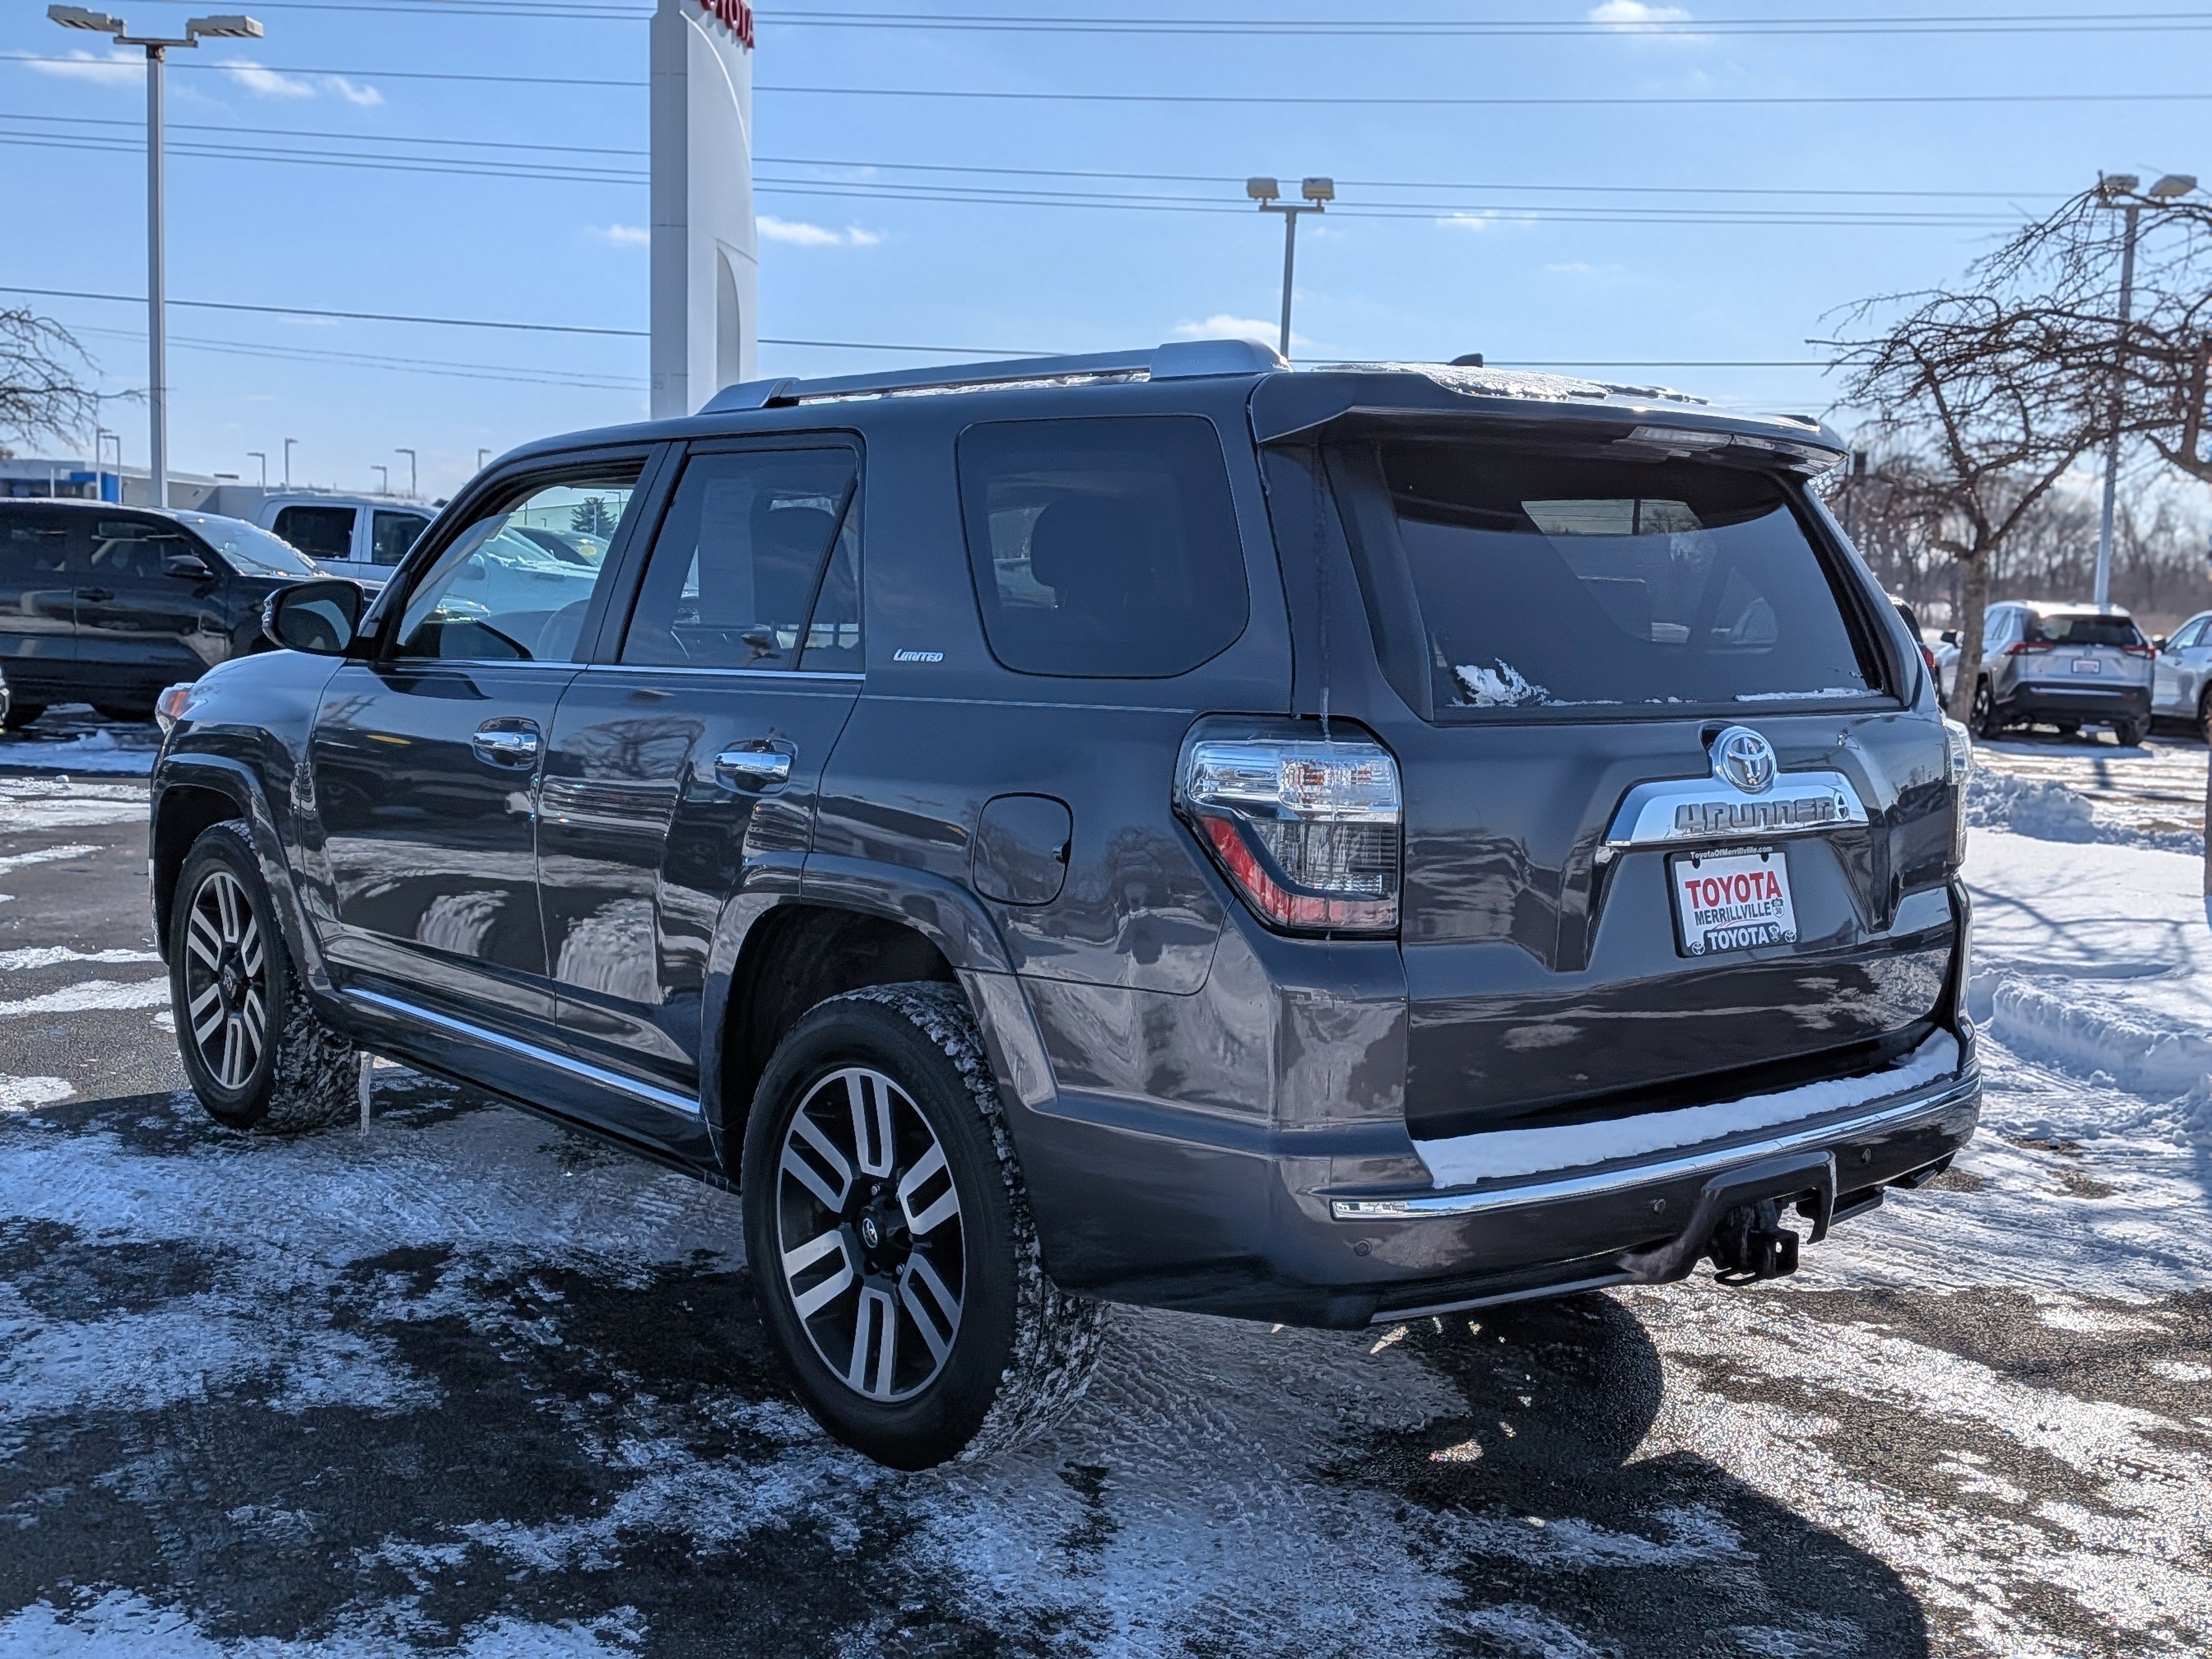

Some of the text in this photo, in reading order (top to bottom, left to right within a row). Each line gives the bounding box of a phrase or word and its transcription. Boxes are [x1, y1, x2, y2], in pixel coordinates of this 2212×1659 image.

[1674, 796, 1836, 832] 4RUNNER
[1684, 870, 1783, 909] TOYOTA
[1694, 901, 1772, 926] MERRILLVILLE
[1707, 926, 1770, 951] TOYOTA
